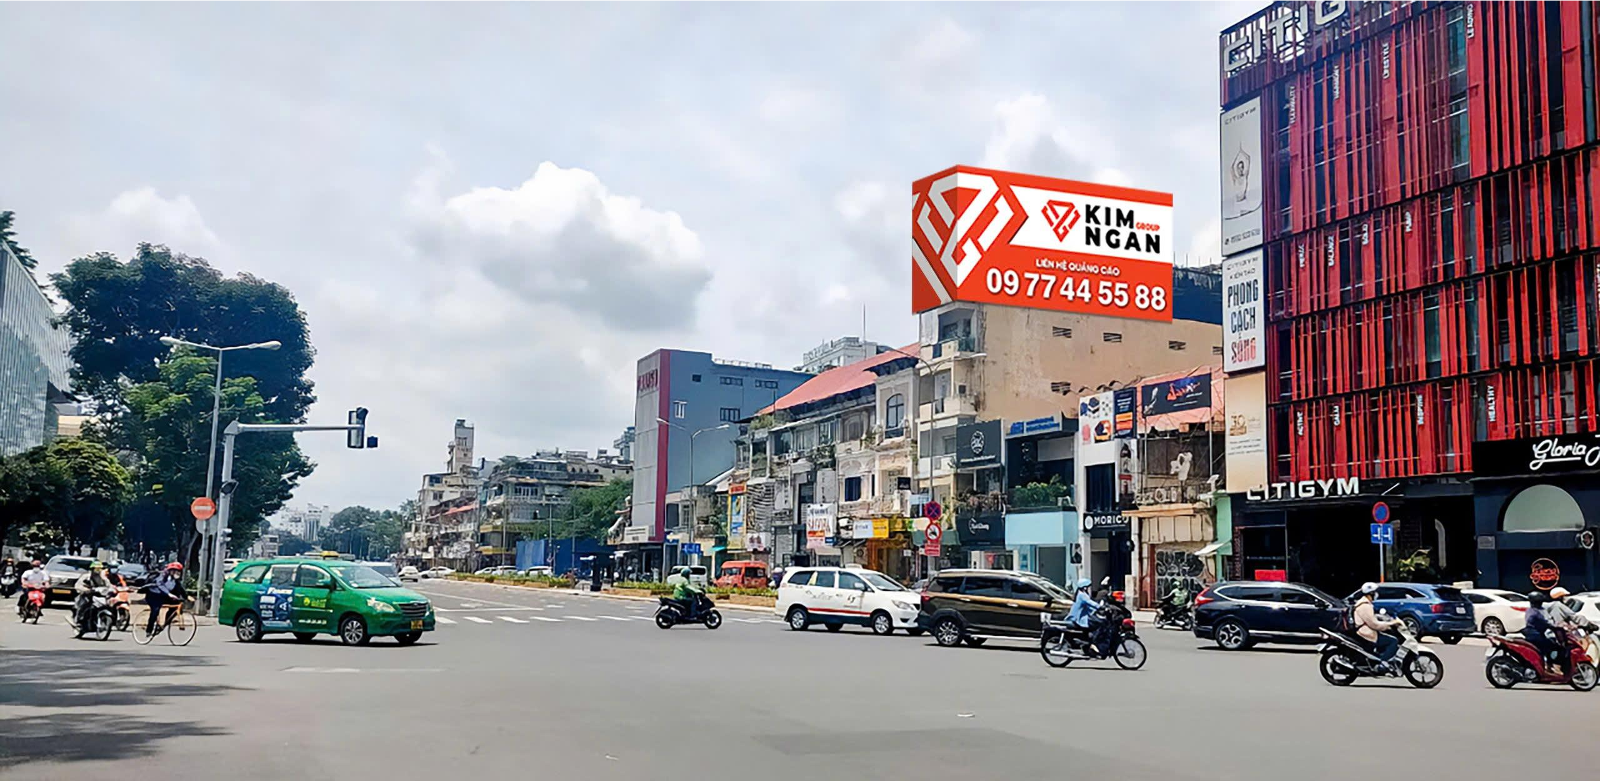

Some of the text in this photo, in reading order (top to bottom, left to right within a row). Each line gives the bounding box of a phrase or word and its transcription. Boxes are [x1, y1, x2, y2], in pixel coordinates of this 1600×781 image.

[1085, 204, 1135, 229] KIM
[1136, 222, 1161, 232] GROUP
[1085, 226, 1161, 254] NGAN
[986, 267, 1020, 296] 09
[1097, 280, 1129, 307] 55
[1134, 284, 1167, 311] 88
[1227, 279, 1259, 308] PHONG
[1487, 385, 1496, 422] HEALTHY
[1529, 437, 1587, 470] Gloria
[1246, 476, 1360, 500] CITIGYM
